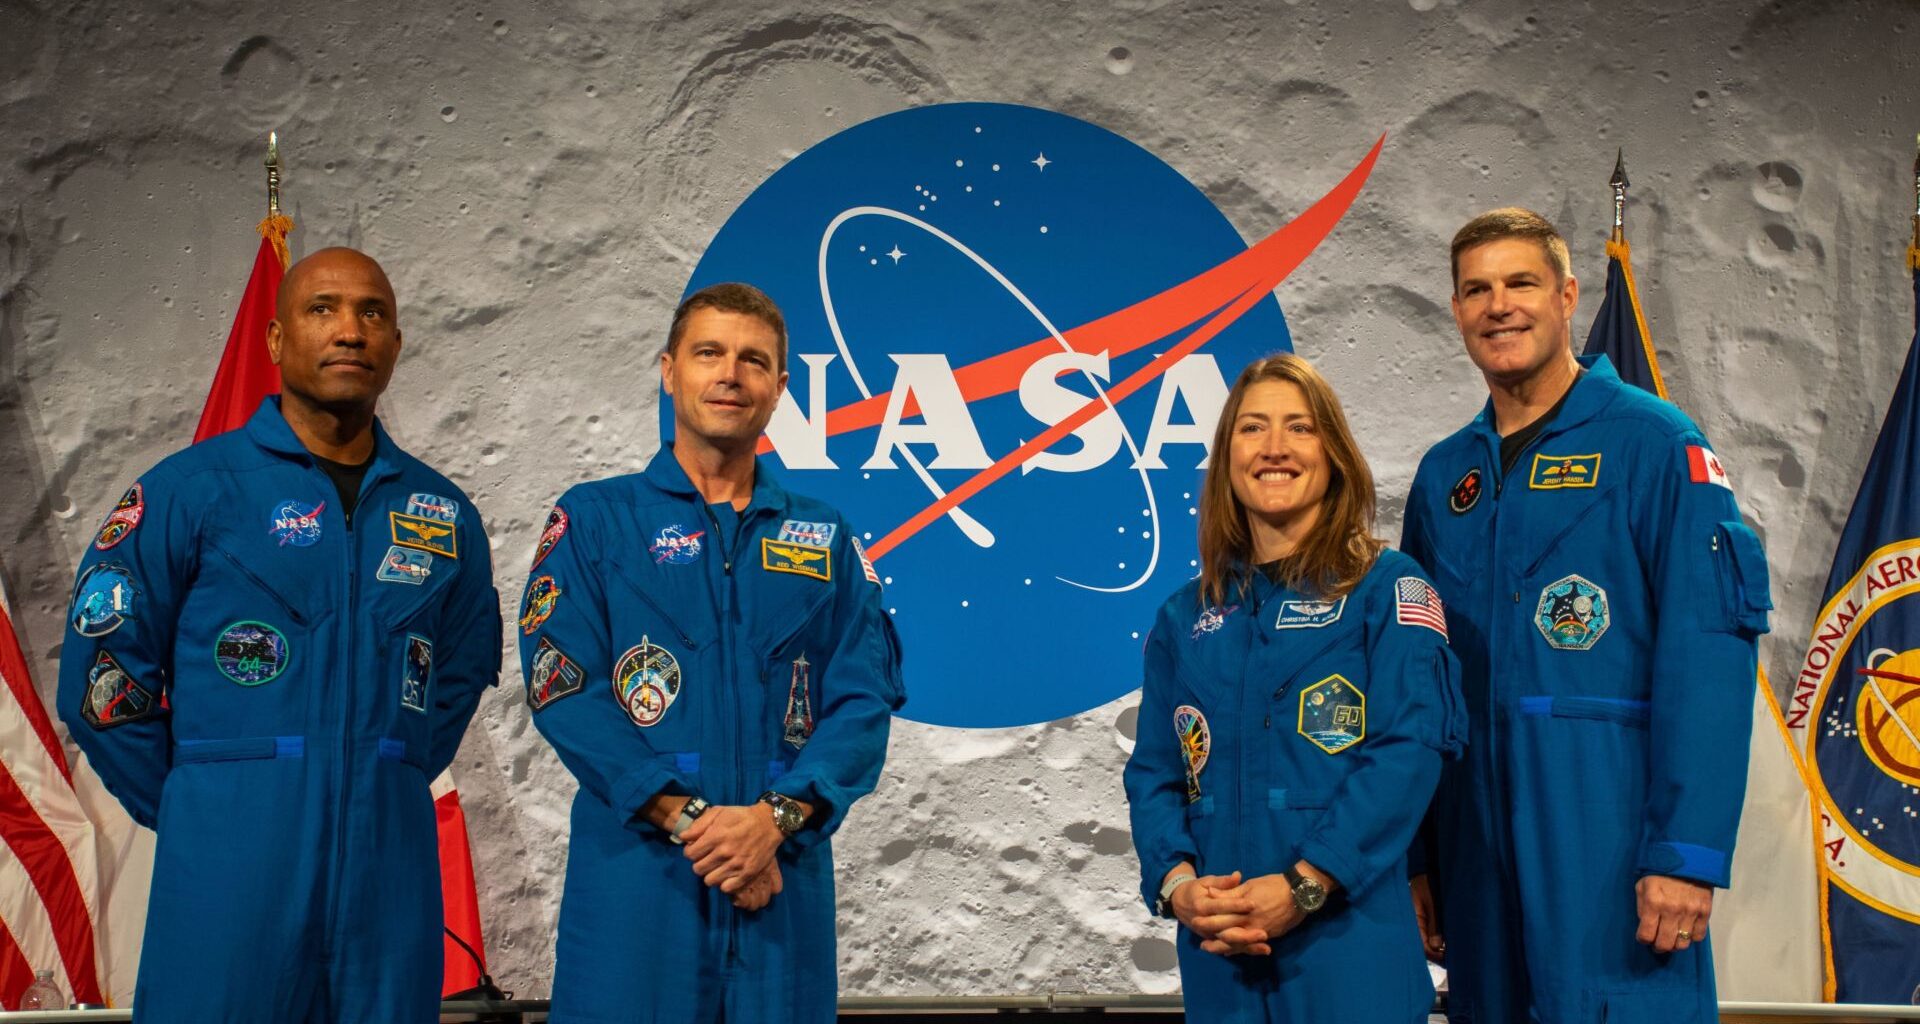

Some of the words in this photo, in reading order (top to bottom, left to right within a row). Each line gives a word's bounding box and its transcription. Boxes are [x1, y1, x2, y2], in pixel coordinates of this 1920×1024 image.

[764, 348, 1230, 476] NASA
[275, 517, 320, 530] NASA
[655, 537, 701, 548] NASA
[792, 563, 818, 574] WISEMAN
[112, 582, 122, 611] 1
[1786, 600, 1862, 728] NATIONAL
[1866, 554, 1920, 599] AER
[238, 656, 260, 672] 64
[1333, 705, 1362, 727] 60
